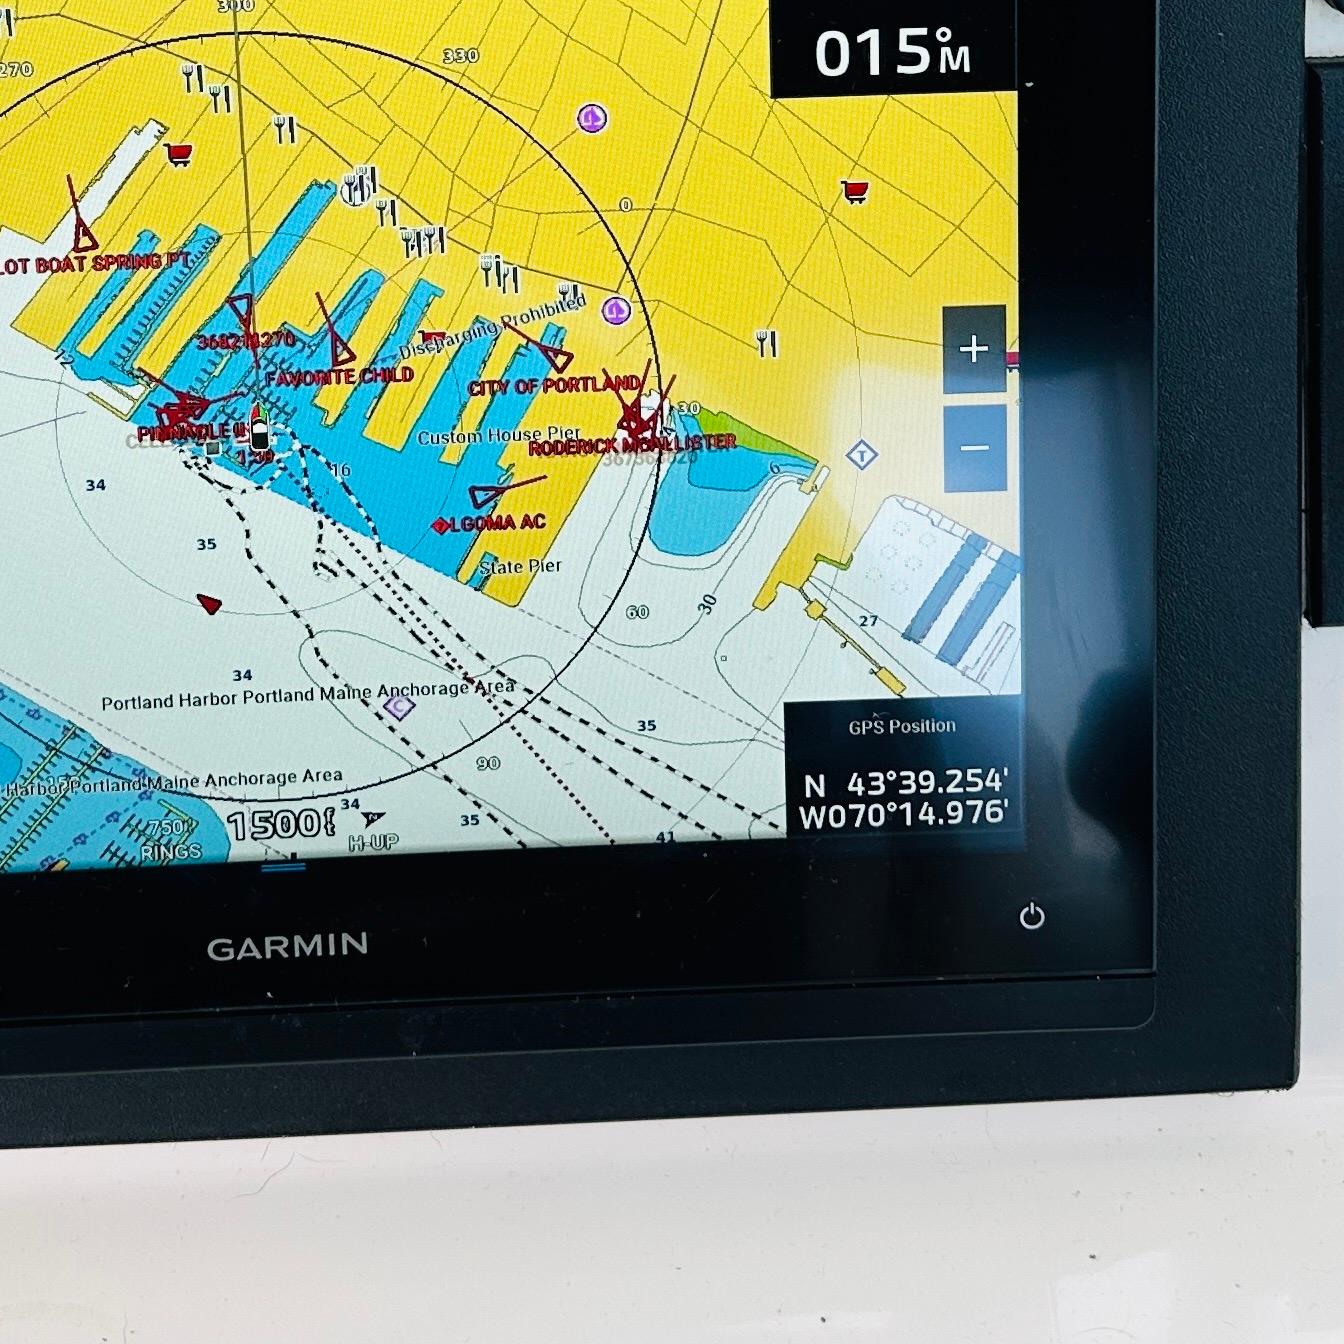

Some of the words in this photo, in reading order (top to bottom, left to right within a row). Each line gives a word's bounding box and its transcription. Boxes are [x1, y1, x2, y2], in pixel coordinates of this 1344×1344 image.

[443, 48, 479, 64] 330
[35, 257, 87, 274] BOAT
[92, 254, 162, 272] SPRING
[166, 252, 190, 268] PT
[399, 323, 498, 361] Discharging
[501, 295, 587, 331] Prohibited
[54, 348, 75, 369] 12
[265, 369, 357, 388] FAVORITE
[360, 366, 415, 384] CHILD
[468, 379, 509, 397] CITY
[515, 379, 538, 395] OF
[543, 375, 642, 393] PORTLAND
[678, 402, 702, 415] 30
[418, 431, 482, 445] Custom
[488, 428, 541, 442] House
[546, 426, 581, 440] Pier
[529, 439, 619, 456] RODERICK
[86, 479, 106, 492] 34
[196, 538, 217, 551] 35
[480, 560, 522, 575] State
[529, 559, 562, 572] Pier
[626, 605, 650, 619] 60
[860, 615, 878, 627] 27
[232, 669, 253, 681] 34
[101, 694, 174, 711] Portland
[179, 692, 236, 708] Harbor
[243, 688, 314, 705] Portland
[320, 685, 372, 701] Maine
[377, 681, 469, 698] Anchorage
[475, 679, 515, 694] Area
[637, 720, 657, 732] 35
[849, 720, 884, 735] GPS
[889, 718, 956, 734] Position
[476, 756, 501, 771] 90
[71, 778, 141, 794] Portland
[148, 775, 199, 790] Maine
[205, 769, 297, 788] Anchorage
[302, 768, 343, 782] Area
[805, 774, 825, 798] N
[341, 798, 360, 810] 34
[460, 814, 480, 826] 35
[349, 833, 399, 852] H-UP
[141, 843, 202, 861] RINGS
[207, 932, 368, 961] GARMIN
